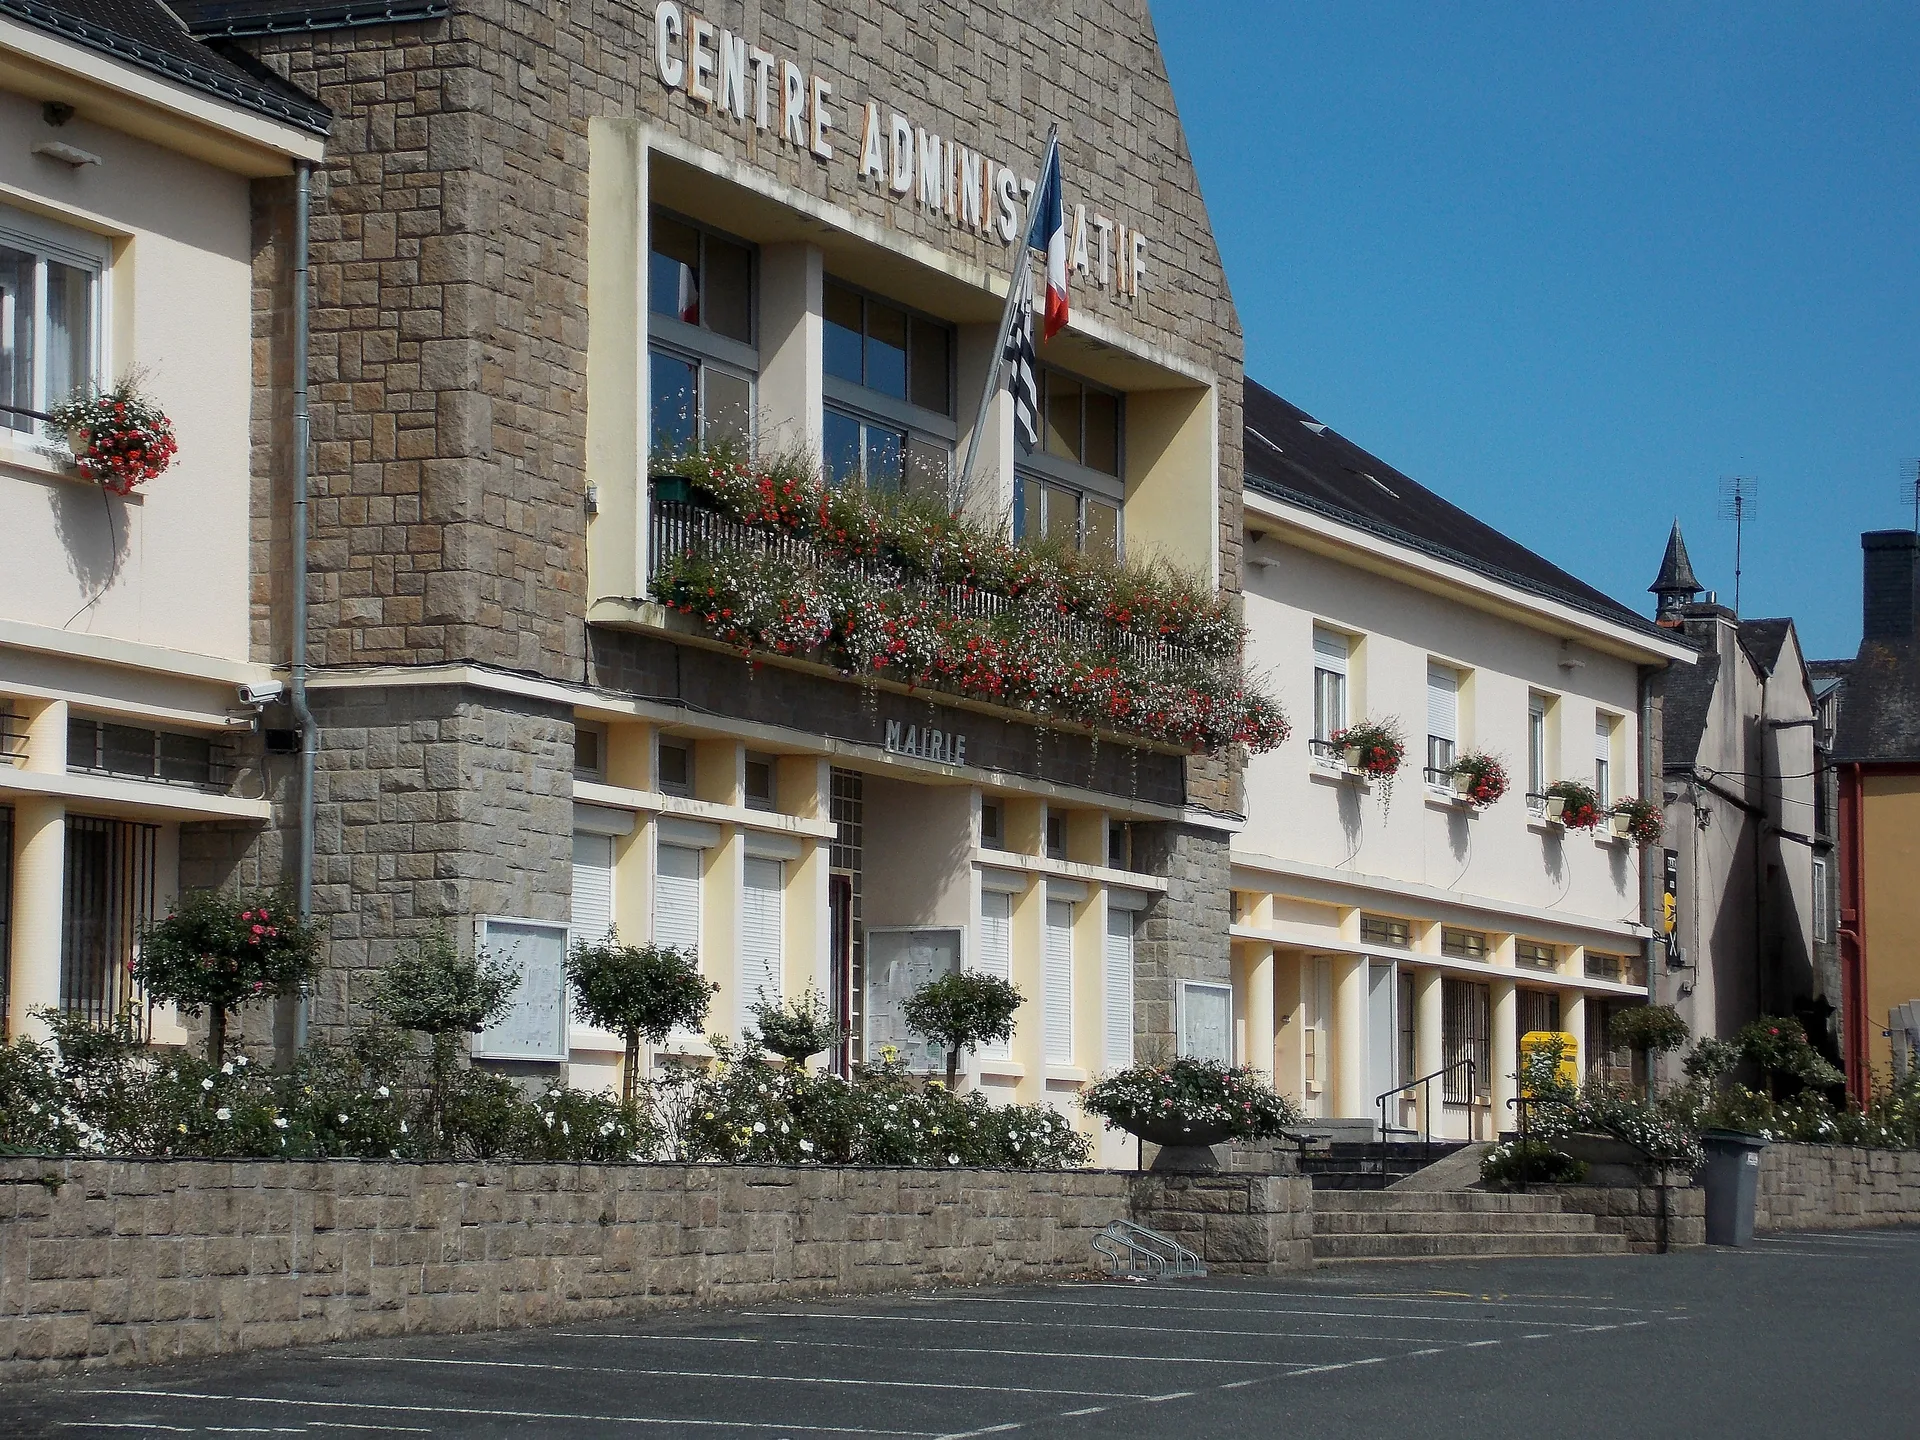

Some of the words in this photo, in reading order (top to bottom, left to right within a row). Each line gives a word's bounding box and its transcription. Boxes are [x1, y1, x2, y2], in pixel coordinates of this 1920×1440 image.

[655, 1, 832, 159] CENTRE
[858, 102, 1146, 297] ADMINISATIF
[884, 719, 966, 766] MAIRIE
